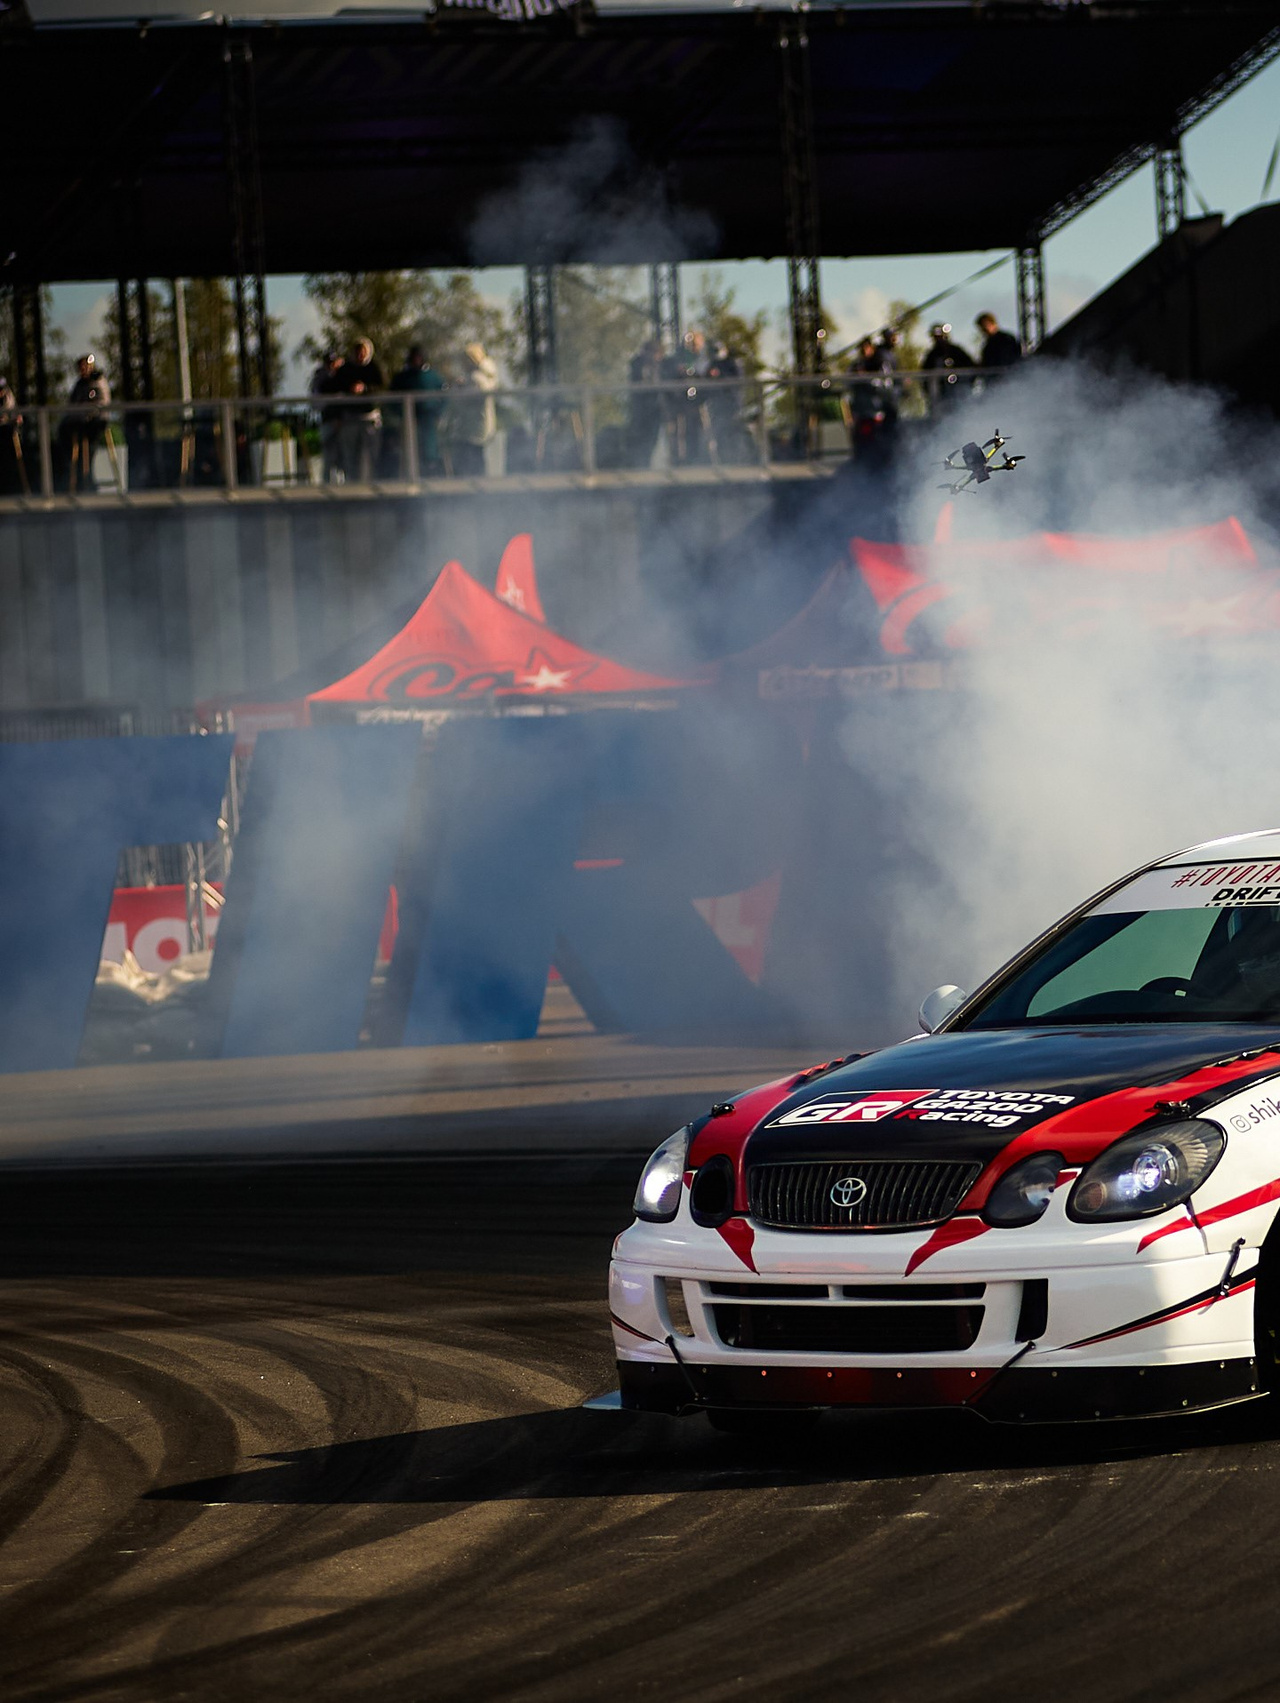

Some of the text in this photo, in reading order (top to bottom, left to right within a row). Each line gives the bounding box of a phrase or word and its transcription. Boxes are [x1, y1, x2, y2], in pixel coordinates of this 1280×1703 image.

[938, 1089, 1076, 1105] TOYOTA
[779, 1100, 903, 1124] GR
[913, 1099, 1044, 1114] GAZOO
[893, 1109, 1021, 1127] Racing
